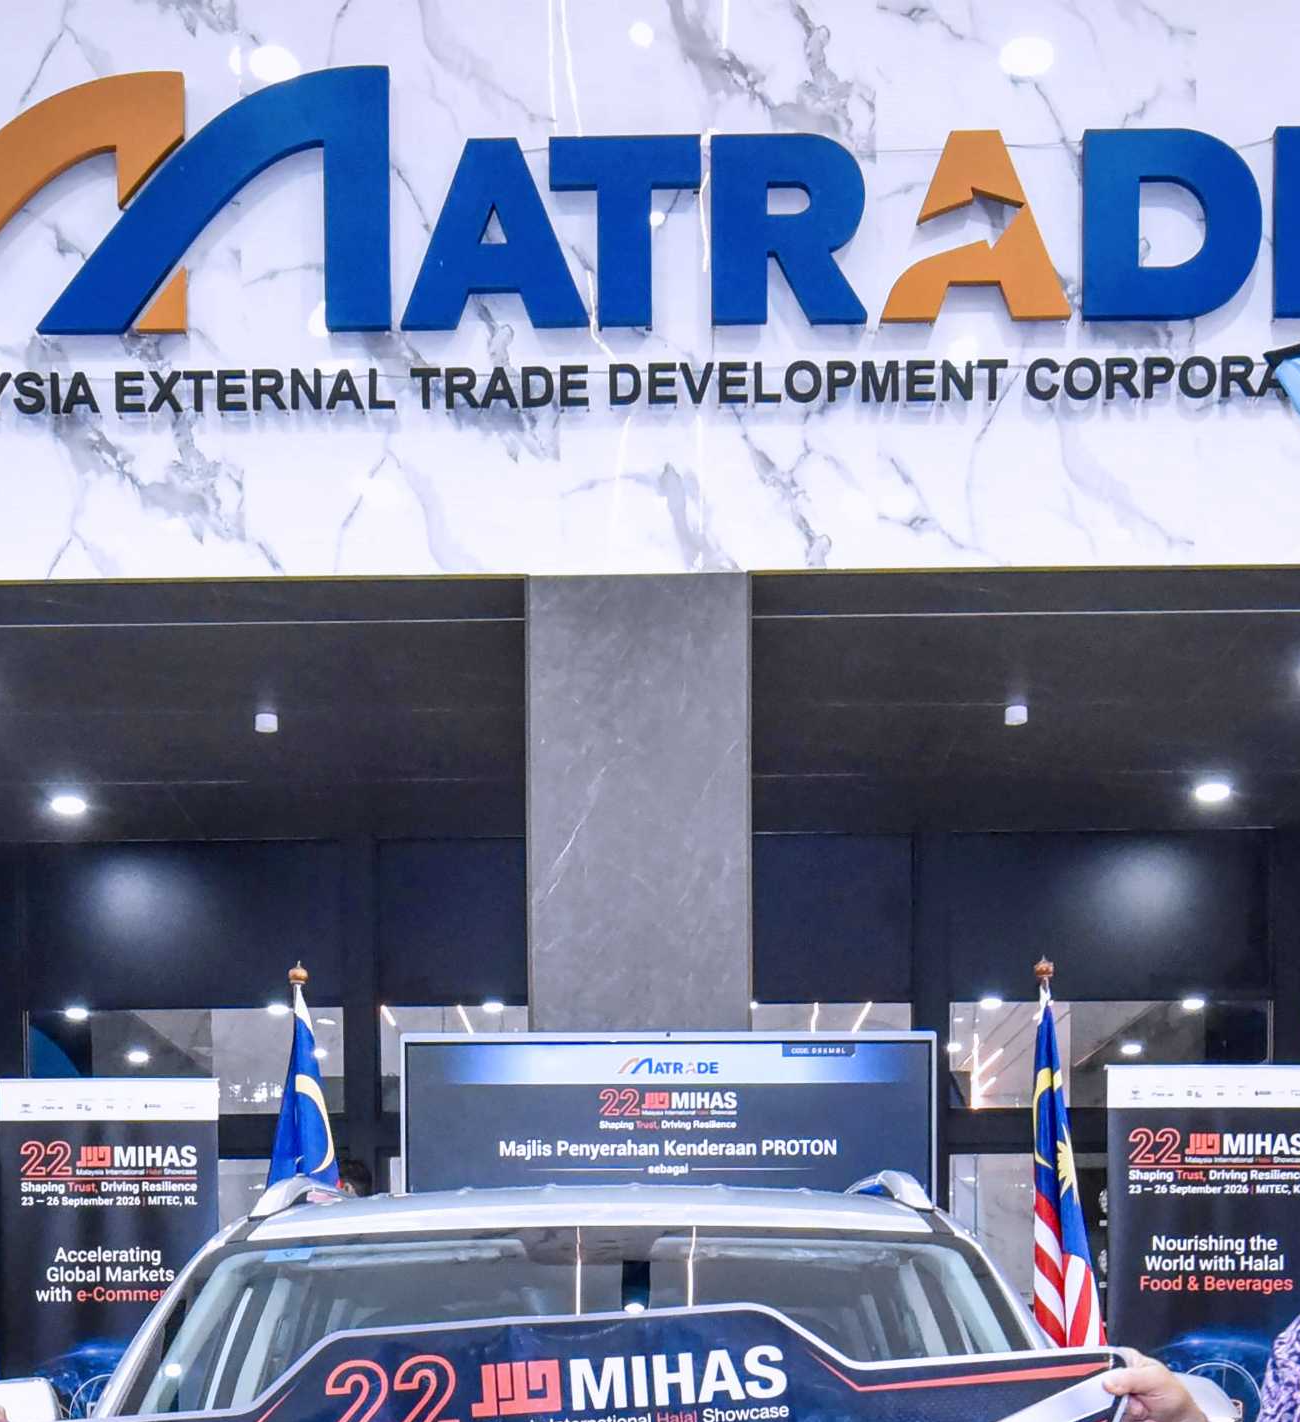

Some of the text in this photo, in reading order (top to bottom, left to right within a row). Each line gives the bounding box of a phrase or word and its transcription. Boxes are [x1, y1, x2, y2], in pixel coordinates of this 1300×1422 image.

[114, 370, 395, 414] EXTERNAL
[410, 366, 588, 408] TRADE
[607, 358, 1007, 406] DEVELOPMENT
[1025, 355, 1288, 400] CORPORA
[617, 1057, 719, 1074] MATRADE
[599, 1088, 640, 1116] 22
[671, 1091, 737, 1109] MIHAS
[599, 1120, 634, 1130] Shaping
[661, 1120, 692, 1130] Driving
[693, 1120, 737, 1129] Resilience
[499, 1138, 838, 1160] Majlis Penyerahan Kenderaan PROTON
[1128, 1128, 1181, 1163] 22
[20, 1141, 197, 1176] 22 MIHAS
[648, 1162, 689, 1176] sebagai
[1129, 1170, 1173, 1182] Shaping
[1176, 1170, 1206, 1181] Trust,
[1209, 1170, 1247, 1182] Driving
[21, 1182, 197, 1194] Shaping Trust, Driving Resilience
[1129, 1185, 1141, 1194] 23
[1155, 1185, 1167, 1194] 26
[1169, 1184, 1221, 1195] September
[1224, 1185, 1248, 1194] 2026
[1256, 1185, 1291, 1195] MITEC,
[21, 1197, 34, 1206] 23
[47, 1197, 59, 1206] 26
[62, 1197, 114, 1207] September
[116, 1197, 140, 1206] 2026
[148, 1196, 182, 1207] MITEC,
[185, 1196, 197, 1205] KL
[1152, 1235, 1277, 1254] Nourishing the
[55, 1246, 161, 1265] Accelerating
[1145, 1254, 1284, 1271] World with Halal
[46, 1266, 175, 1282] Global Markets
[1140, 1275, 1293, 1294] Food & Beverages
[36, 1286, 166, 1302] with e-Commer
[569, 1345, 788, 1411] MIHAS
